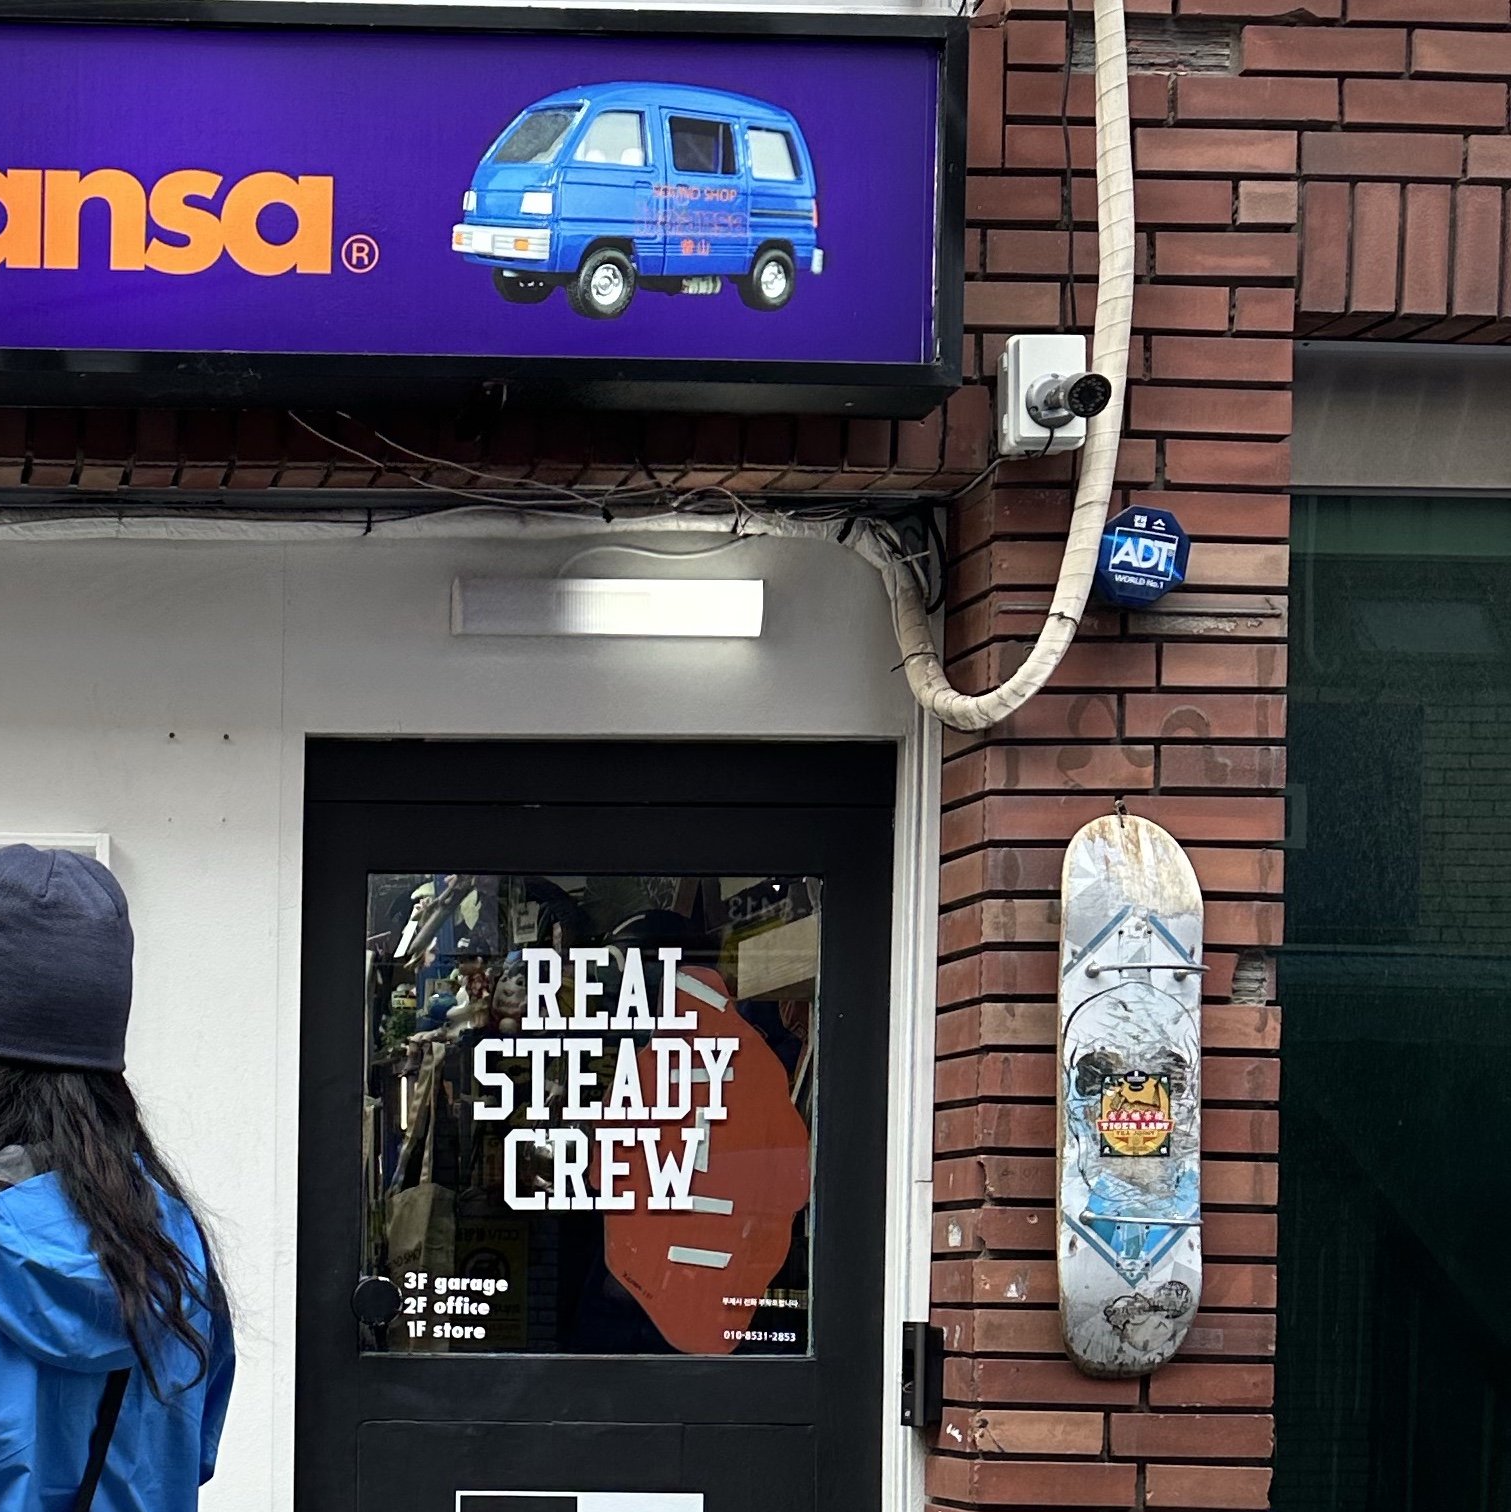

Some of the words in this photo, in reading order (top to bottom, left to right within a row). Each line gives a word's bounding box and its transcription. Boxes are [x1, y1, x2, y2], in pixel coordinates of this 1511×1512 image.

[1111, 537, 1176, 572] ADT
[1114, 573, 1145, 586] WORLD
[521, 947, 698, 1030] REAL
[473, 1037, 740, 1121] STEADY
[1100, 1122, 1137, 1130] TIGER
[503, 1128, 705, 1211] CREW
[404, 1271, 428, 1290] 3F
[434, 1277, 509, 1297] garage
[403, 1296, 428, 1315] 2F
[433, 1295, 490, 1316] office
[407, 1320, 427, 1338] 1F
[433, 1322, 486, 1340] store
[723, 1330, 797, 1342] 010-8531-2853
